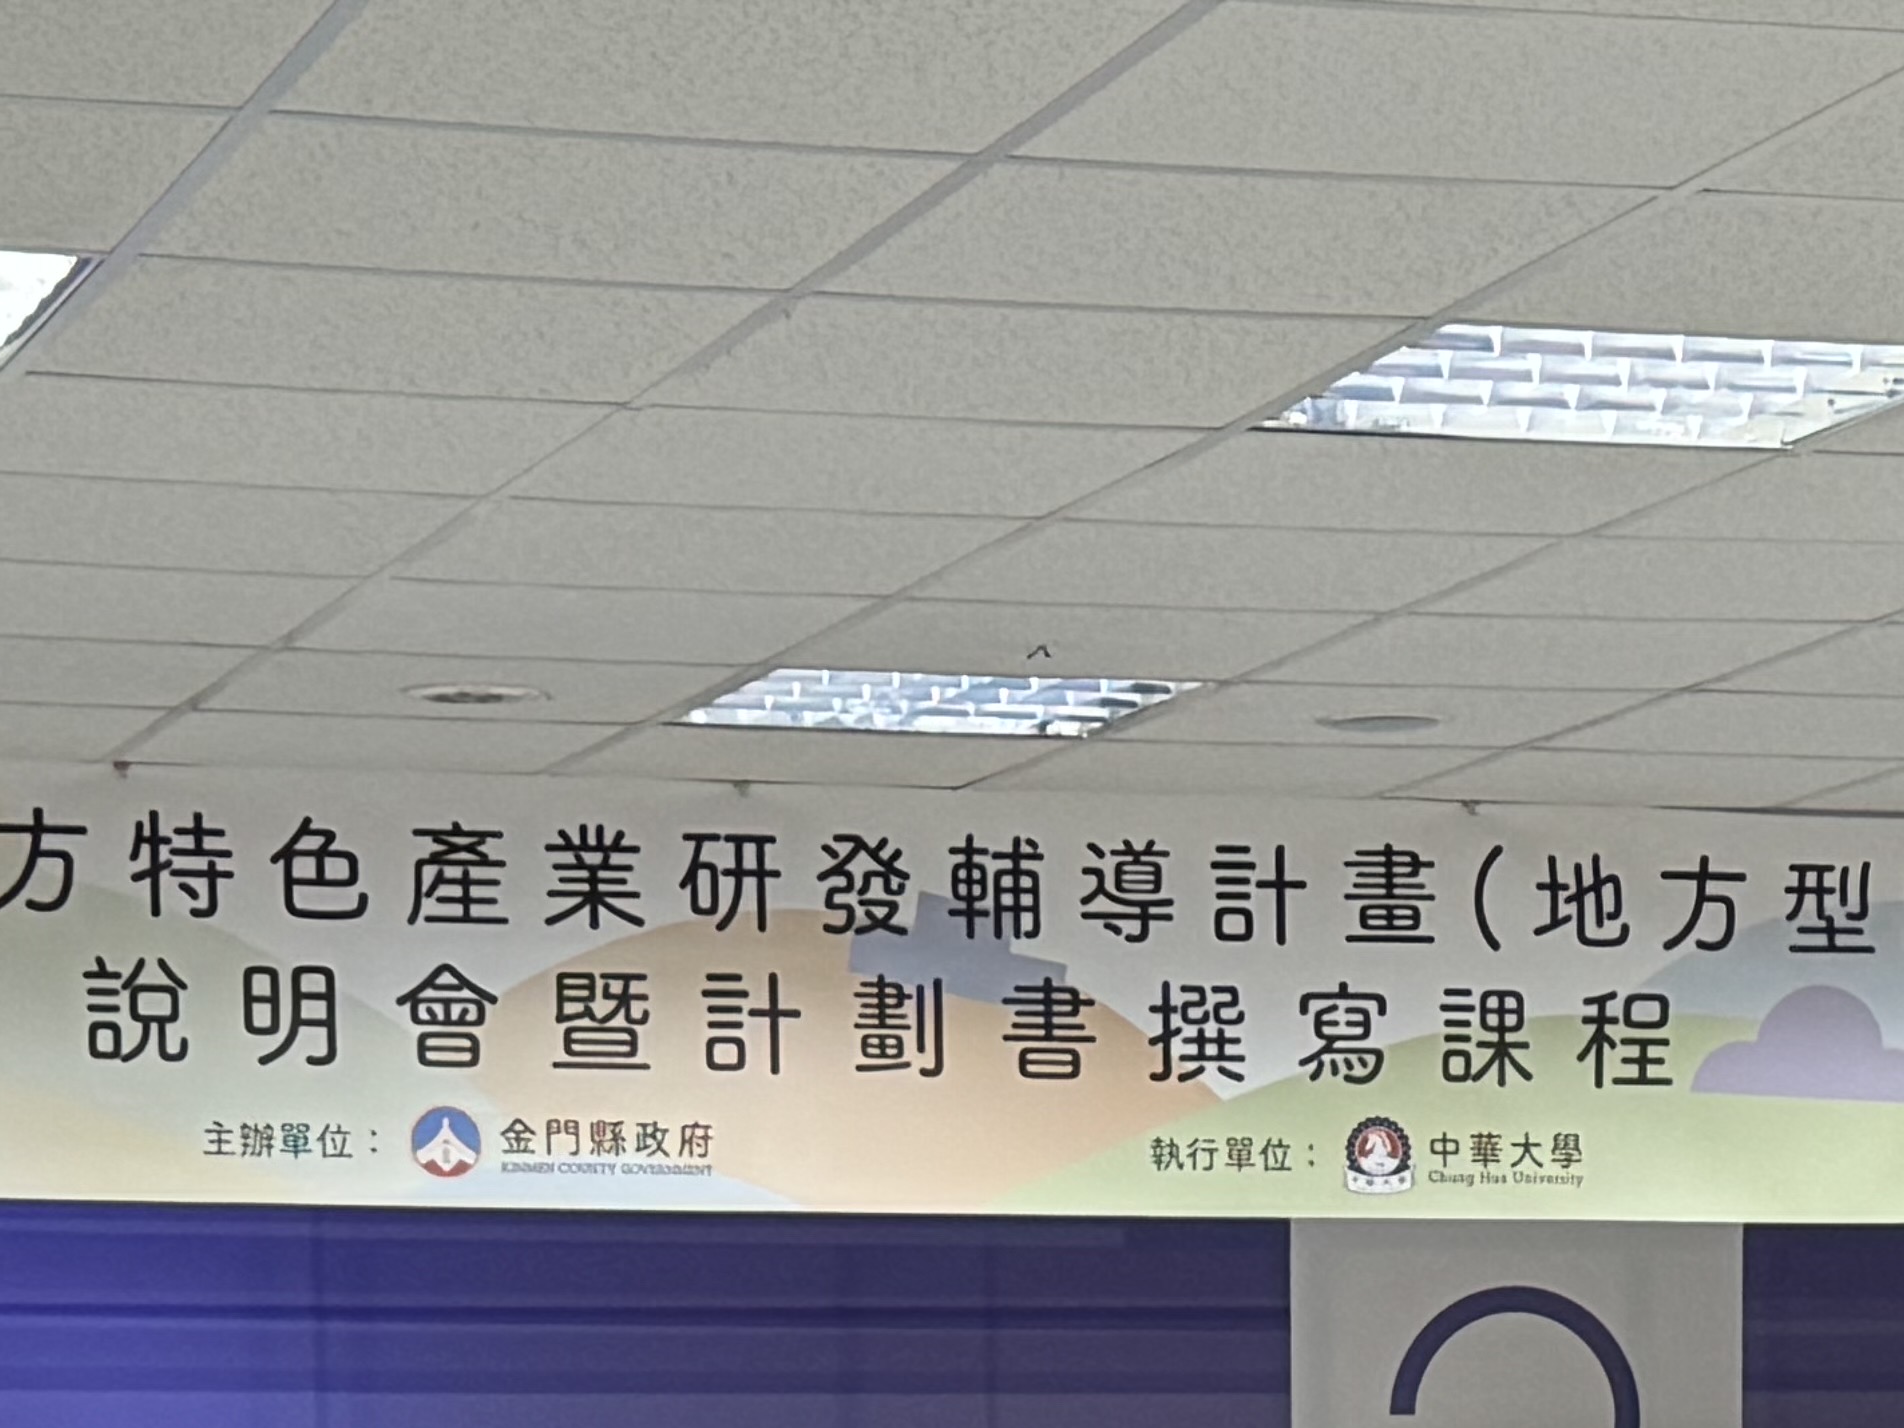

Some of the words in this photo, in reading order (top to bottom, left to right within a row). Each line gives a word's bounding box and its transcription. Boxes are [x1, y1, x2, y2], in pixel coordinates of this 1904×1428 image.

[82, 957, 1675, 1090] 說明會暨計劃書撰寫課程
[499, 1117, 714, 1158] 金門縣政府
[1429, 1131, 1583, 1168] 中華大學
[1512, 1170, 1584, 1188] University
